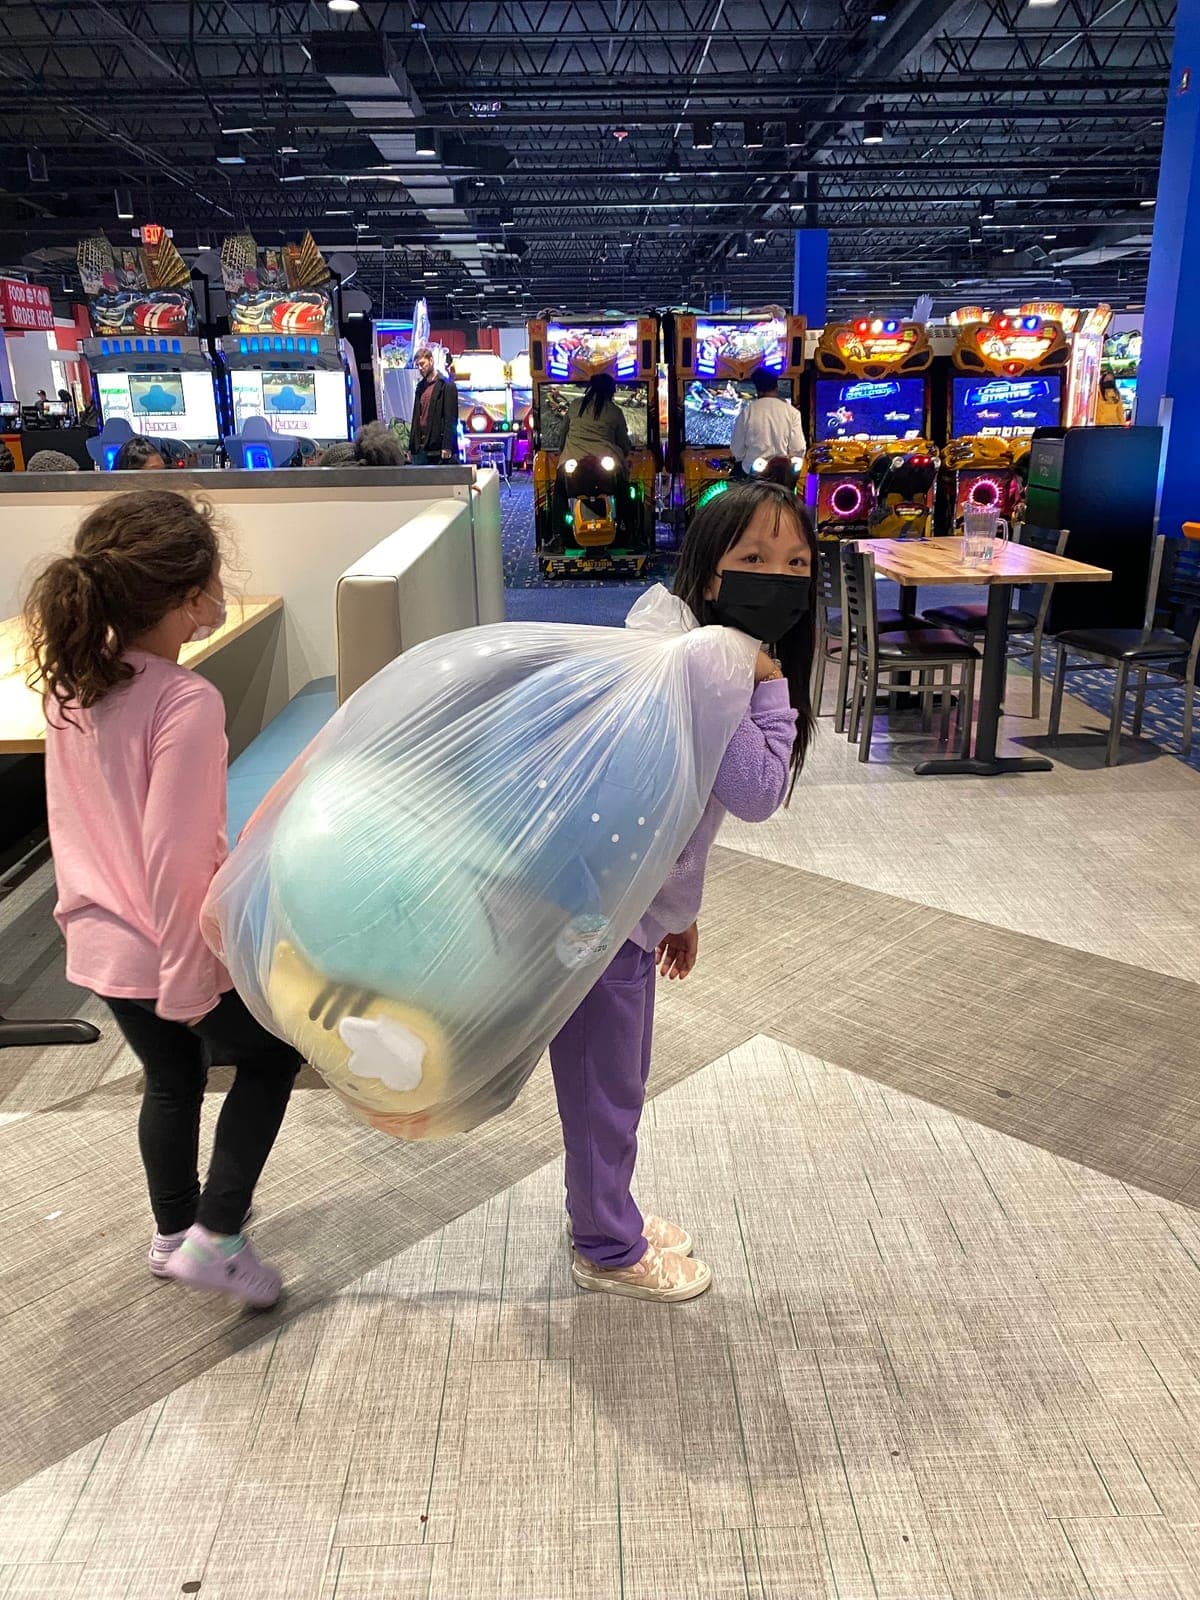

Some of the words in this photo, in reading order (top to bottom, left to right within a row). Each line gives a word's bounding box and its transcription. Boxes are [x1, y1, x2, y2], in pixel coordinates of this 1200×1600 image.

[143, 226, 162, 241] EXIT
[8, 284, 25, 302] FOOD
[12, 304, 36, 326] ORDER
[36, 309, 54, 329] HERE
[146, 422, 178, 432] LIVE
[276, 420, 308, 430] LIVE
